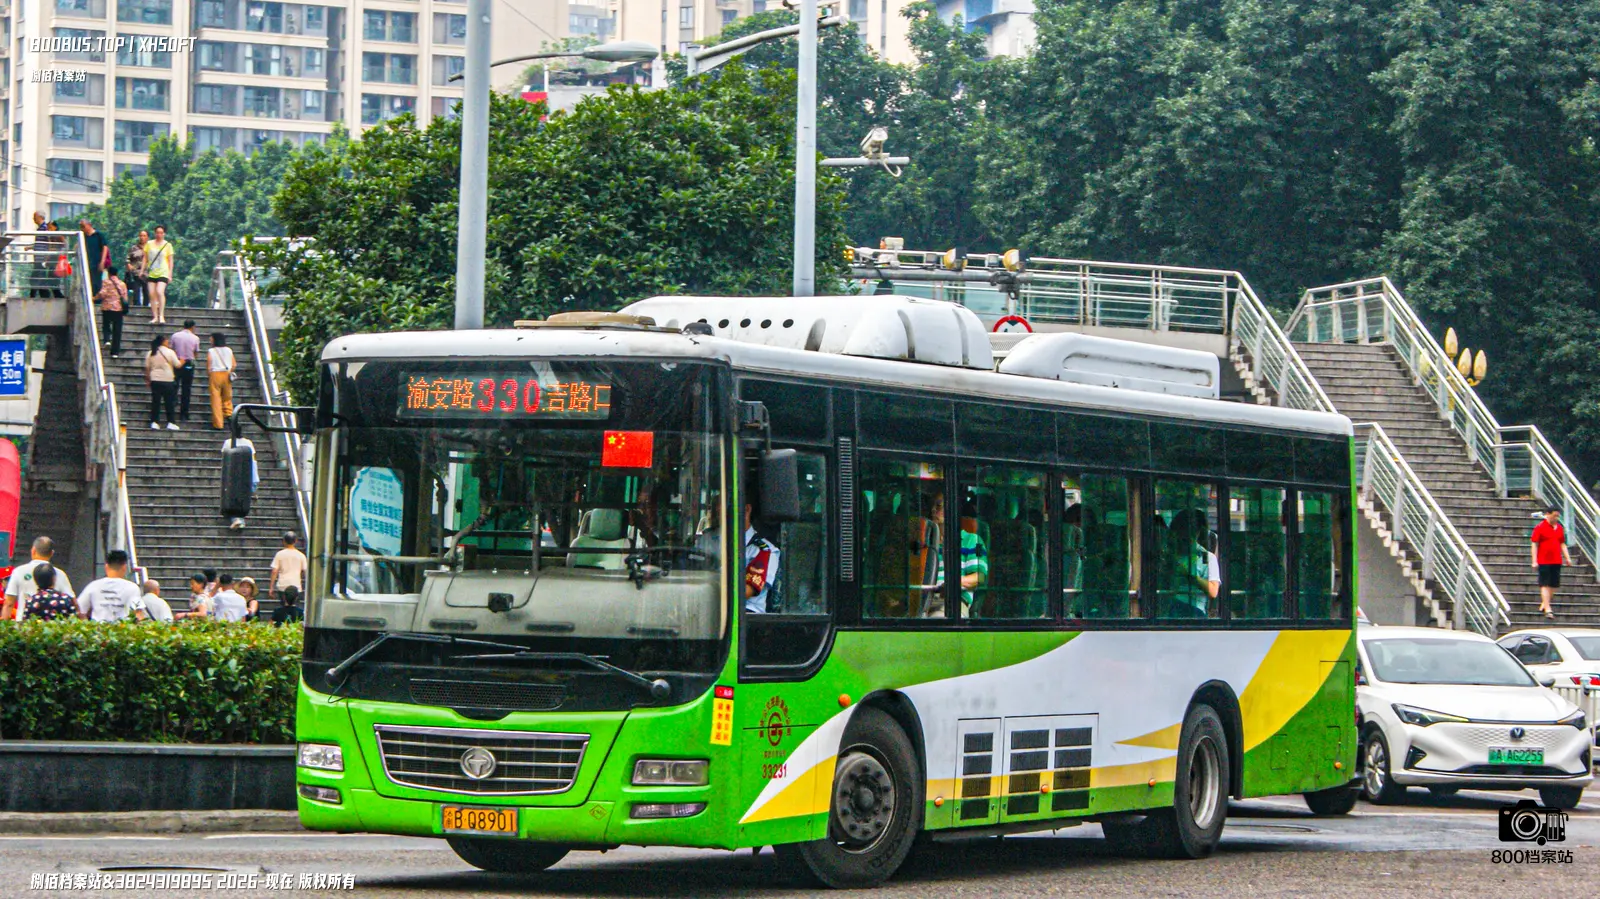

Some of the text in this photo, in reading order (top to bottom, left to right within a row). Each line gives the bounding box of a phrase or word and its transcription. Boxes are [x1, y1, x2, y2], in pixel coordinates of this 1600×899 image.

[407, 377, 474, 409] 渝安路
[477, 378, 541, 413] 330
[762, 763, 787, 779] 33231
